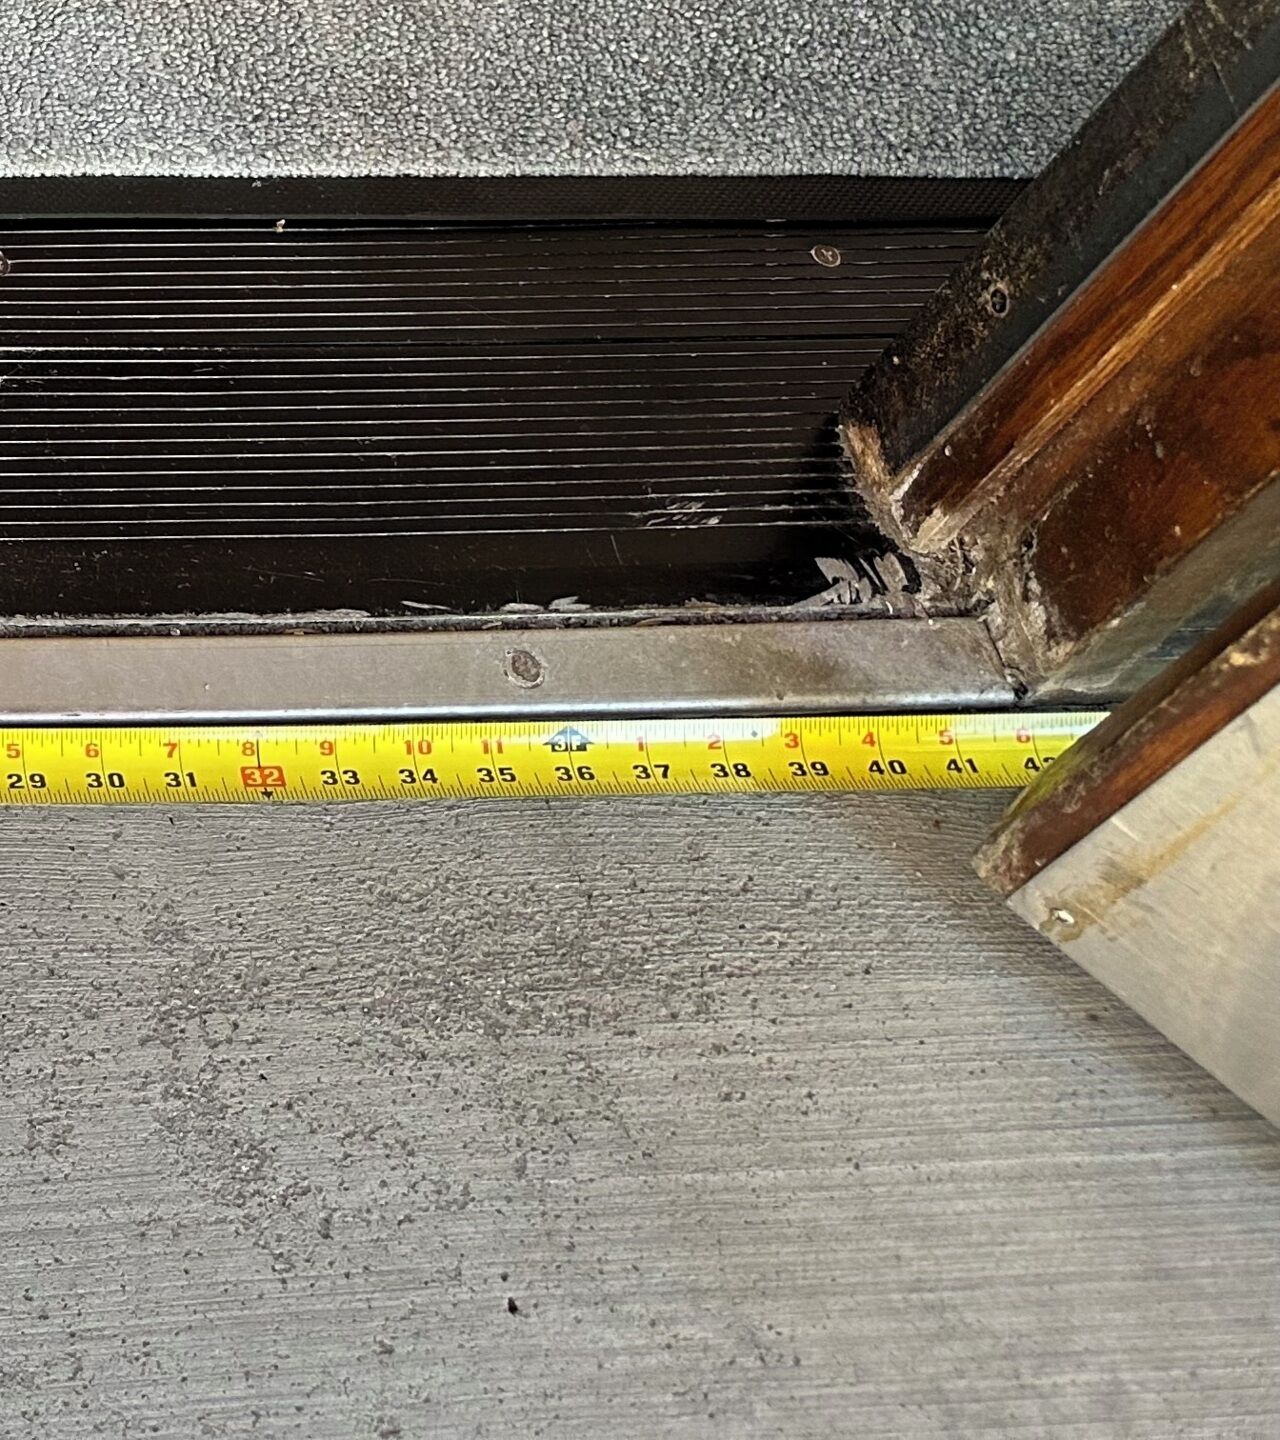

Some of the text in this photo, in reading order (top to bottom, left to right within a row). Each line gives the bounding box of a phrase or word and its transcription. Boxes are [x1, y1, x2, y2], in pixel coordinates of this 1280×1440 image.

[6, 743, 21, 759] 5
[85, 743, 100, 758] 6
[164, 742, 179, 758] 7
[242, 741, 256, 757] 8
[319, 741, 335, 757] 9
[403, 740, 433, 756] 10
[482, 740, 505, 756] 11
[554, 735, 582, 752] 3F
[635, 736, 645, 752] 1
[707, 735, 722, 750] 2
[784, 733, 800, 749] 3
[861, 731, 876, 747] 4
[939, 730, 954, 746] 5
[1016, 728, 1032, 744] 6
[6, 773, 47, 789] 29
[86, 772, 125, 788] 30
[164, 772, 197, 788] 31
[245, 769, 283, 785] 32
[320, 770, 361, 786] 33
[399, 768, 438, 785] 34
[476, 767, 517, 783] 35
[554, 766, 595, 782] 36
[632, 764, 671, 780] 37
[710, 763, 752, 779] 38
[788, 761, 830, 777] 39
[867, 760, 907, 776] 40
[946, 758, 979, 774] 41
